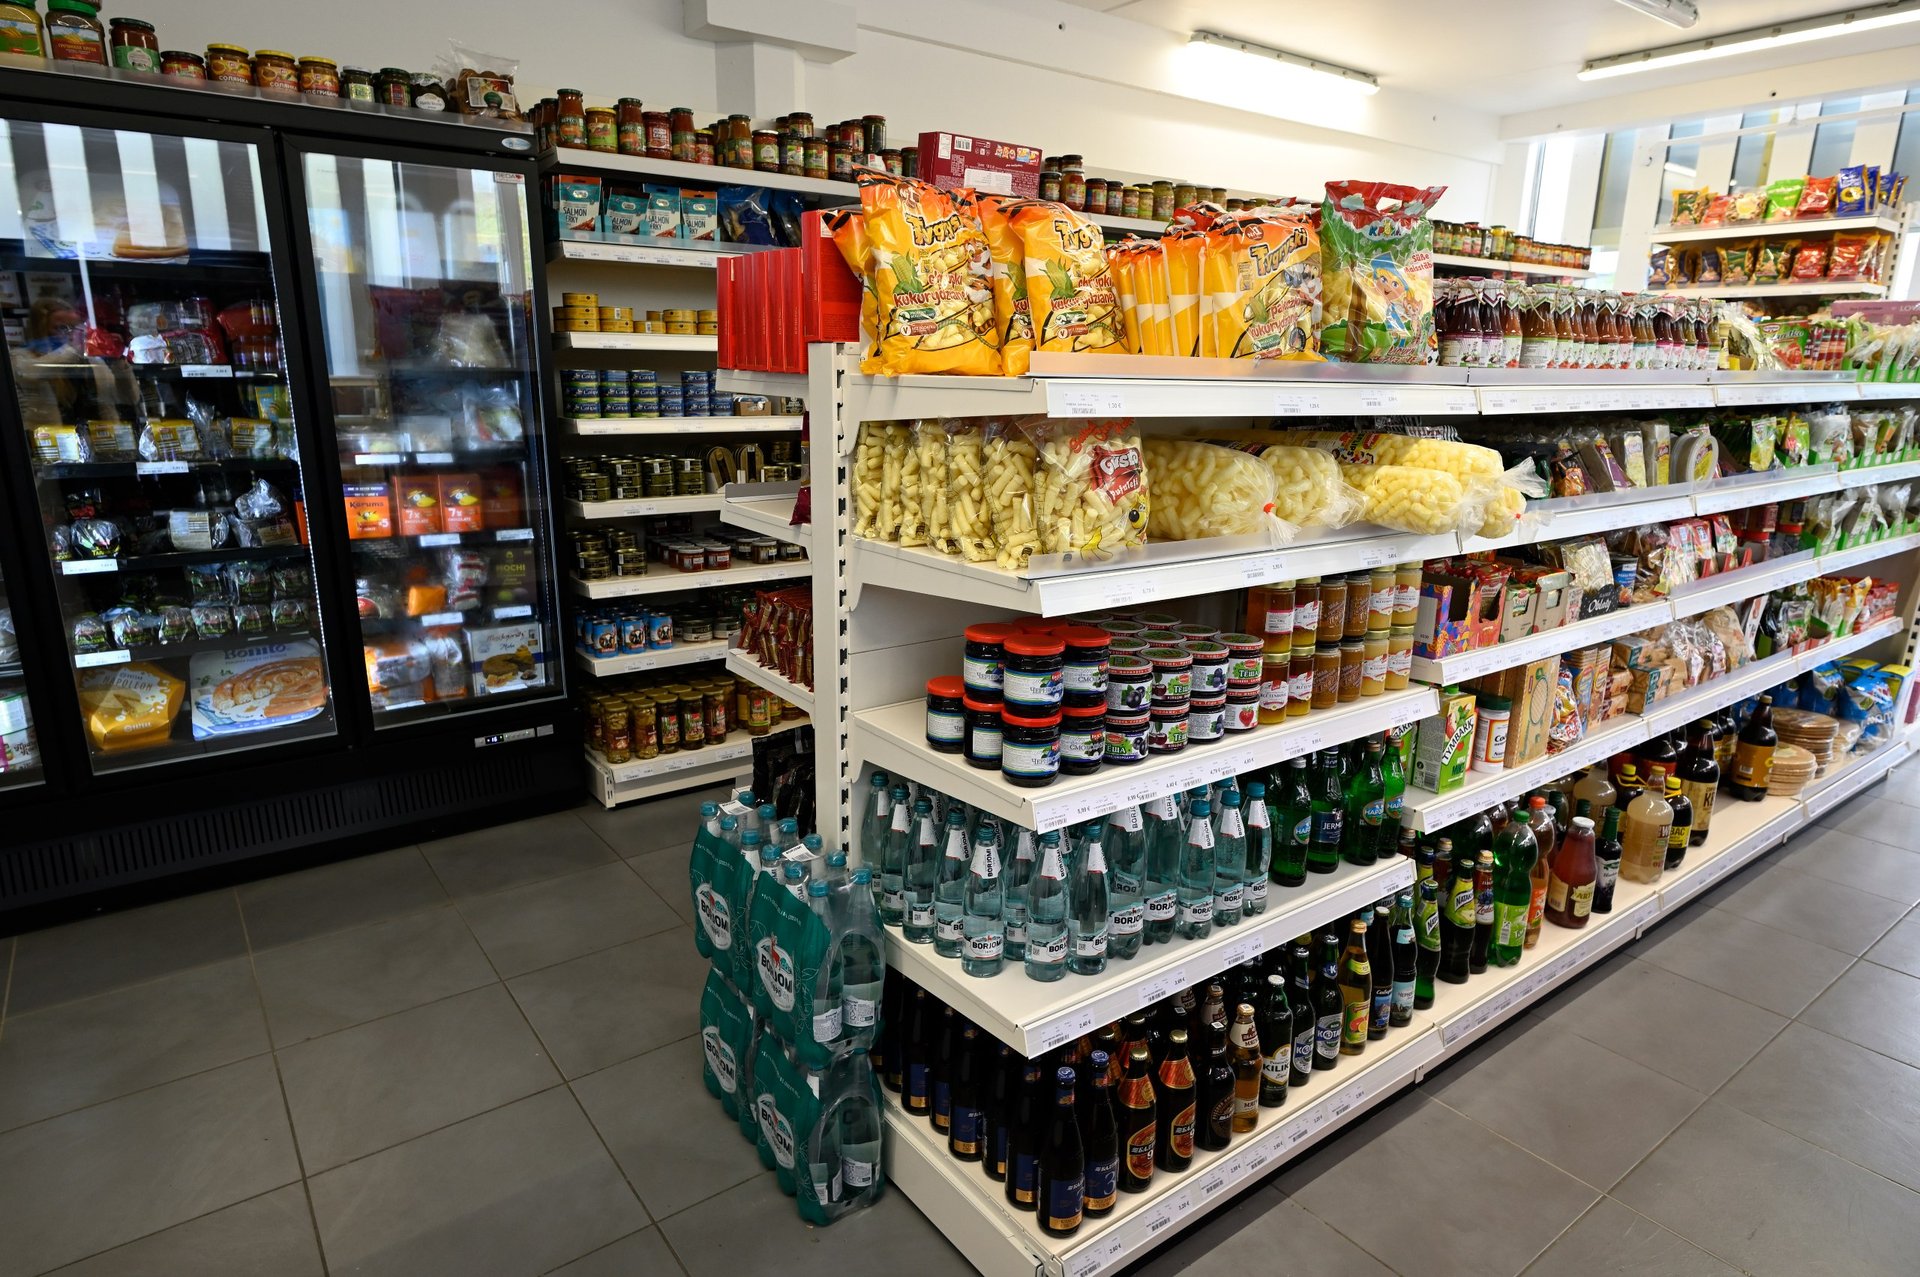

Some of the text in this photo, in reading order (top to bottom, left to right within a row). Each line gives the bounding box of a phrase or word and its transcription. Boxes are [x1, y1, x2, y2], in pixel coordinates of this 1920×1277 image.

[218, 75, 249, 84] СОЛЯНКА
[563, 207, 587, 216] SALMON
[565, 215, 578, 223] ERKY
[1250, 228, 1308, 276] Tygryski
[1412, 252, 1430, 263] Süße
[1442, 718, 1474, 762] TYMBARK
[1203, 820, 1212, 847] BORJOMI
[1670, 827, 1686, 837] ВАС
[986, 848, 994, 877] BORJOMI
[972, 940, 1001, 950] BORJOM
[1263, 1063, 1290, 1072] KILIK
